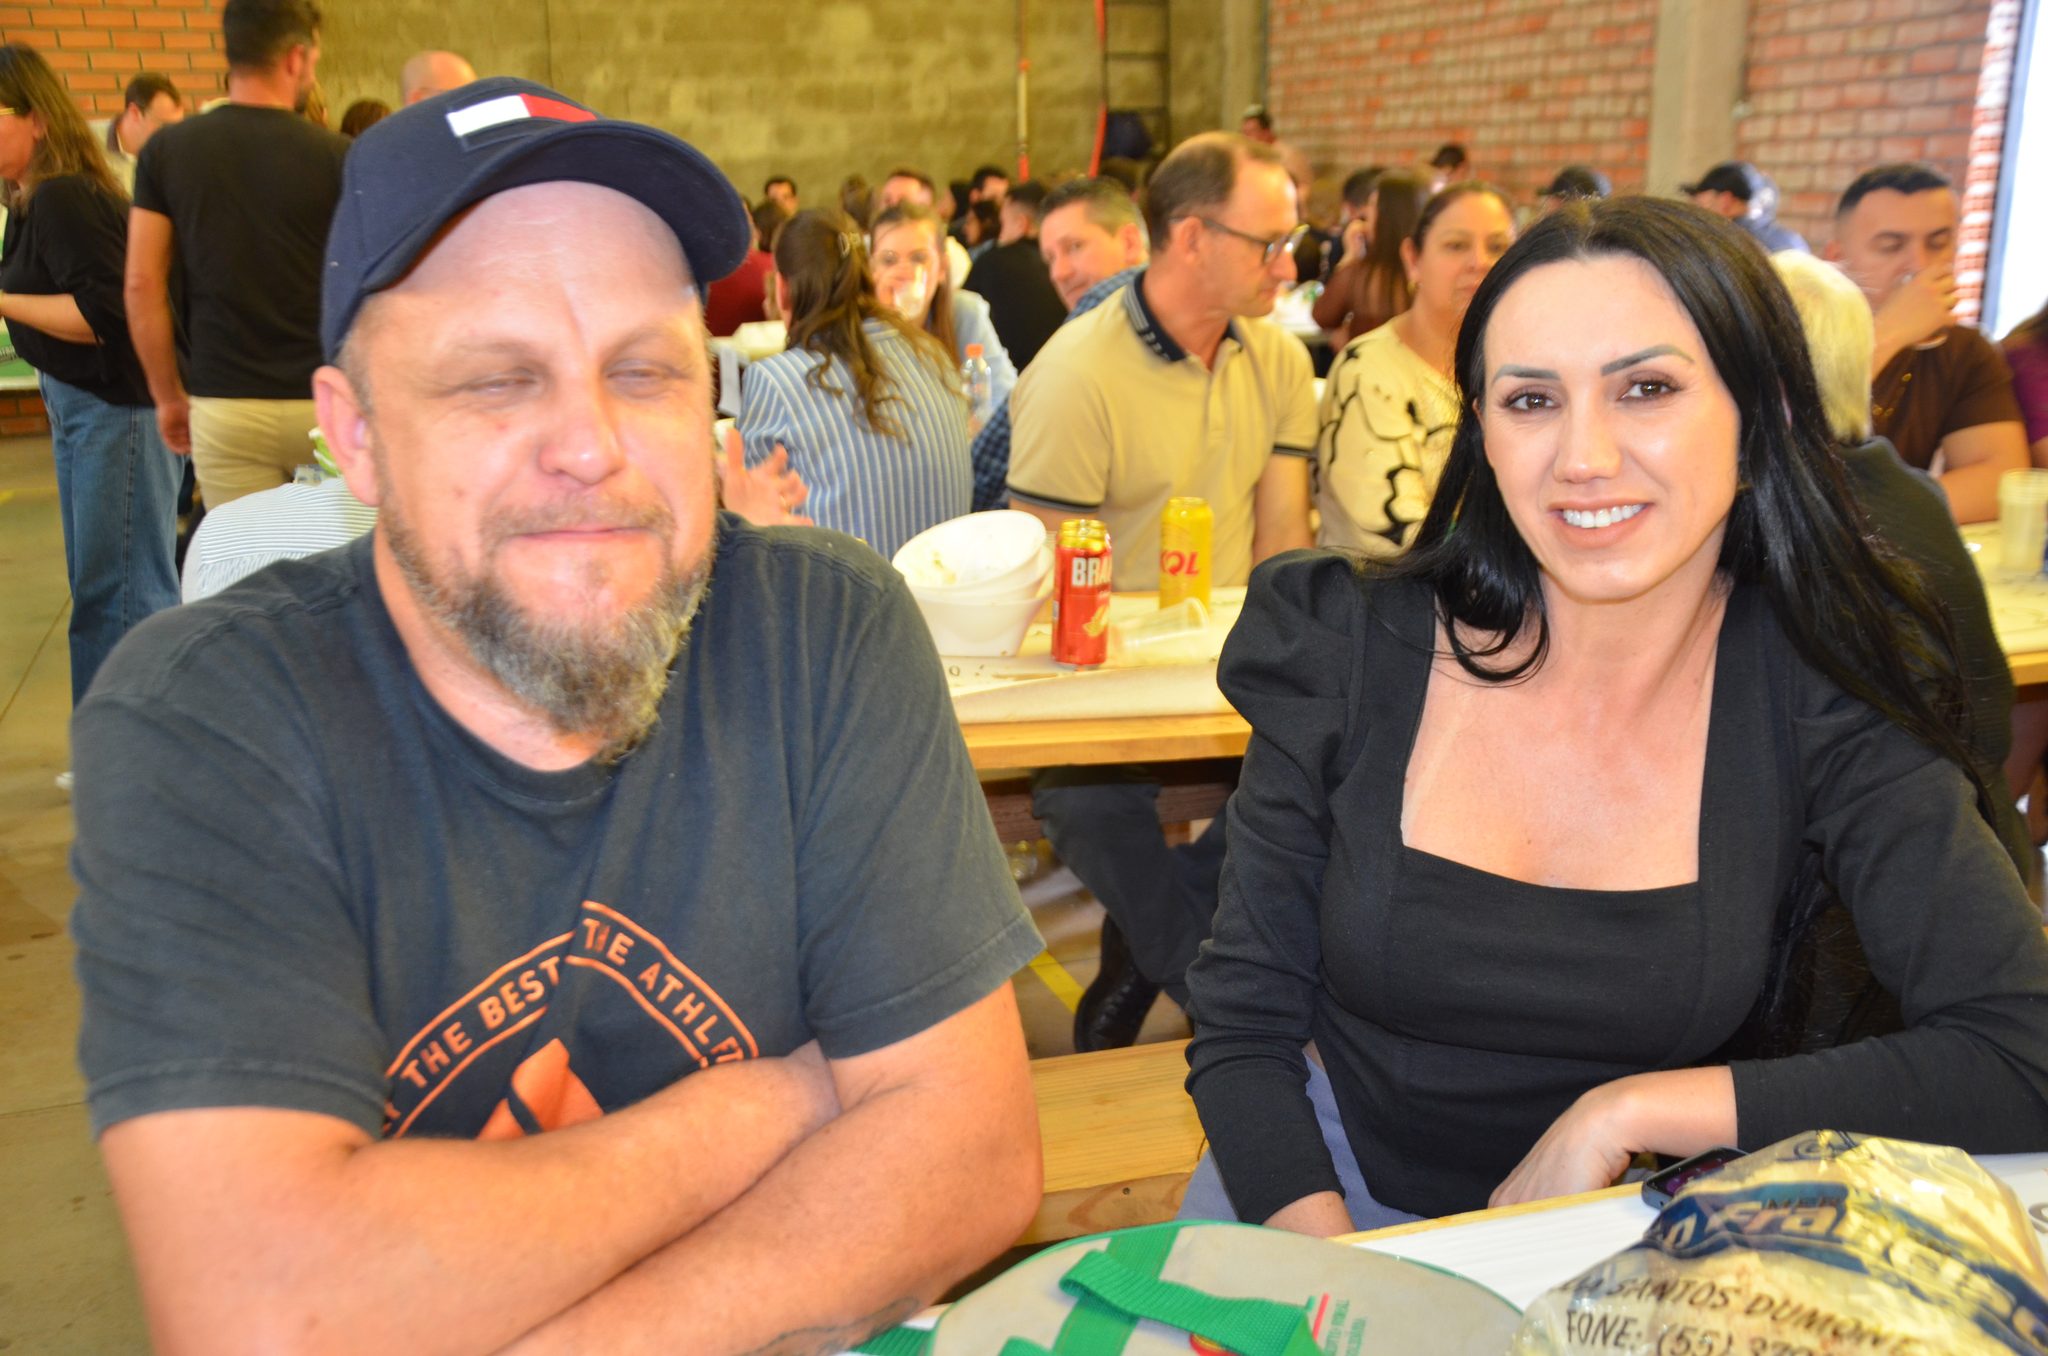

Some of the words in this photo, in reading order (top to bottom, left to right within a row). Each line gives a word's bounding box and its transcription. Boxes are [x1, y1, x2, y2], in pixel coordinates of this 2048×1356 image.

[401, 1022, 473, 1088] THE
[478, 956, 560, 1030] BEST
[1606, 1275, 1742, 1310] SANTOS
